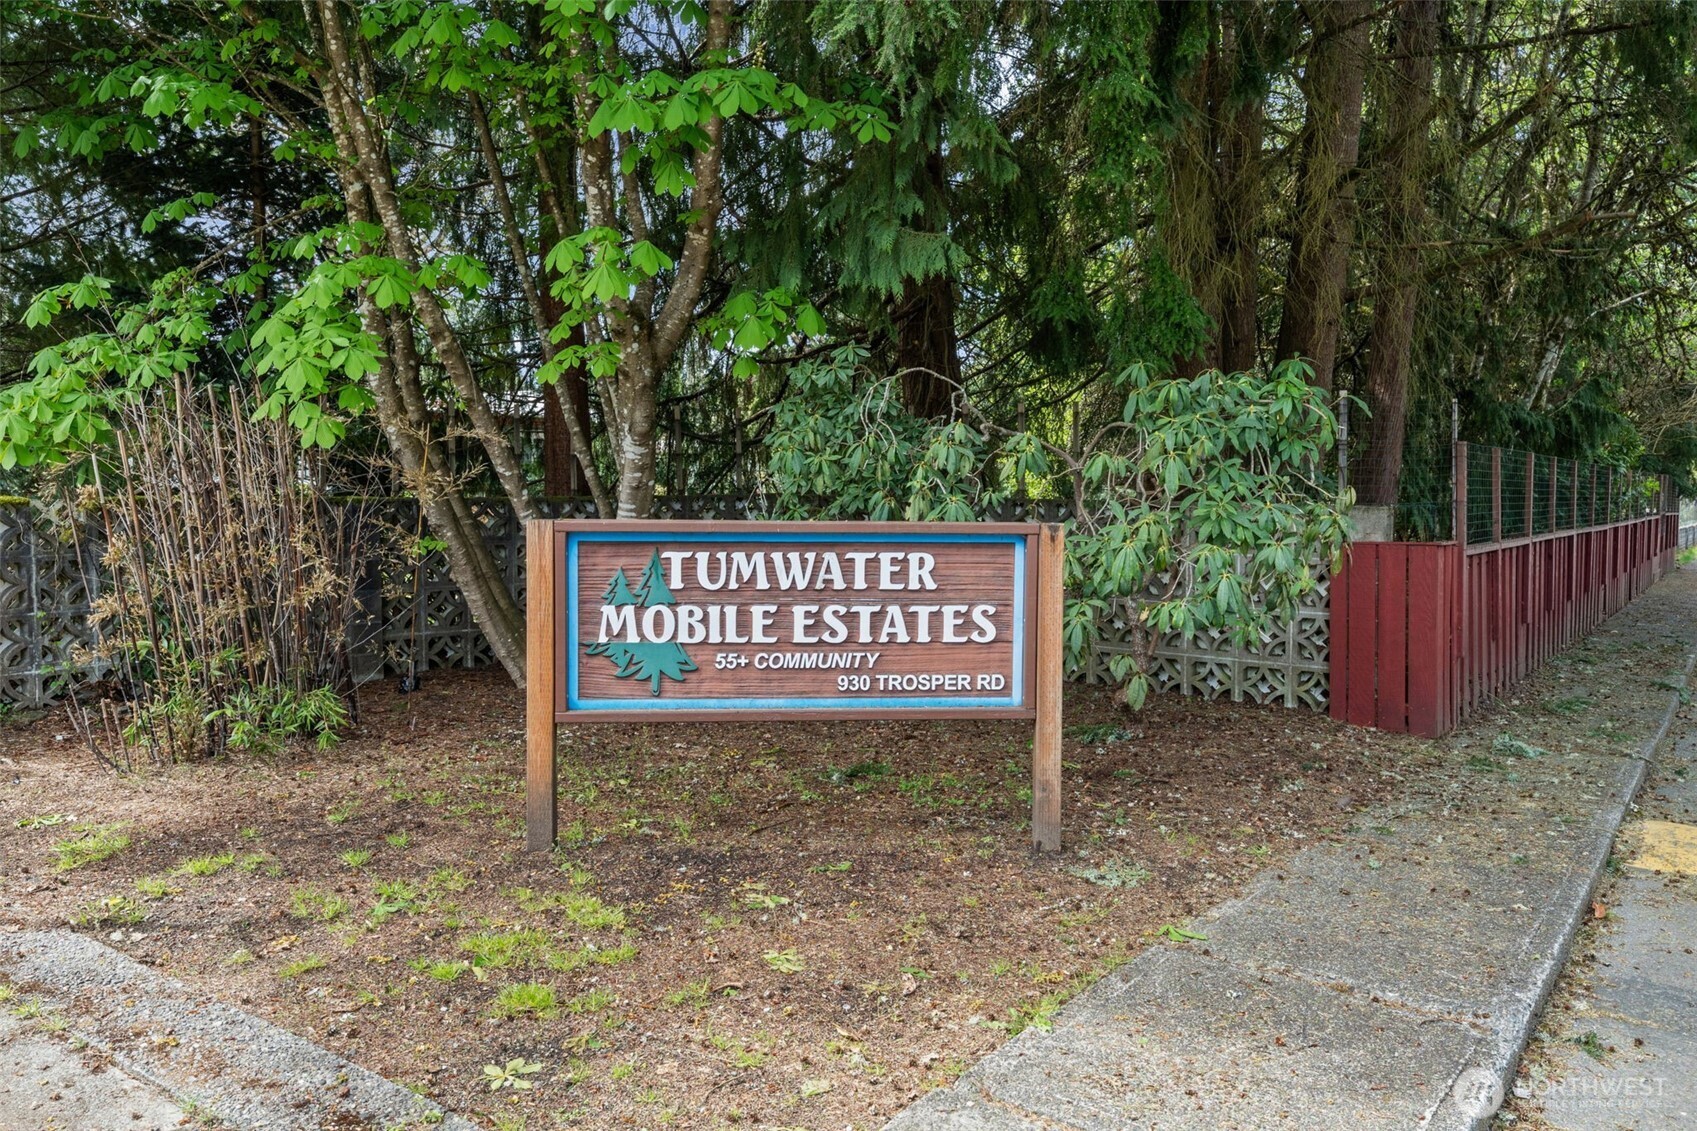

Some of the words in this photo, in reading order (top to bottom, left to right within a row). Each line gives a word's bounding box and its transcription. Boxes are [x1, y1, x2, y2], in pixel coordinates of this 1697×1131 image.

[661, 551, 937, 590] TUMWATER
[598, 604, 778, 643] MOBILE
[792, 604, 998, 643] ESTATES
[714, 653, 749, 669] 55+
[754, 653, 880, 669] COMMUNITY
[837, 675, 871, 690] 930
[876, 675, 970, 691] TROSPER
[976, 675, 1005, 690] RD
